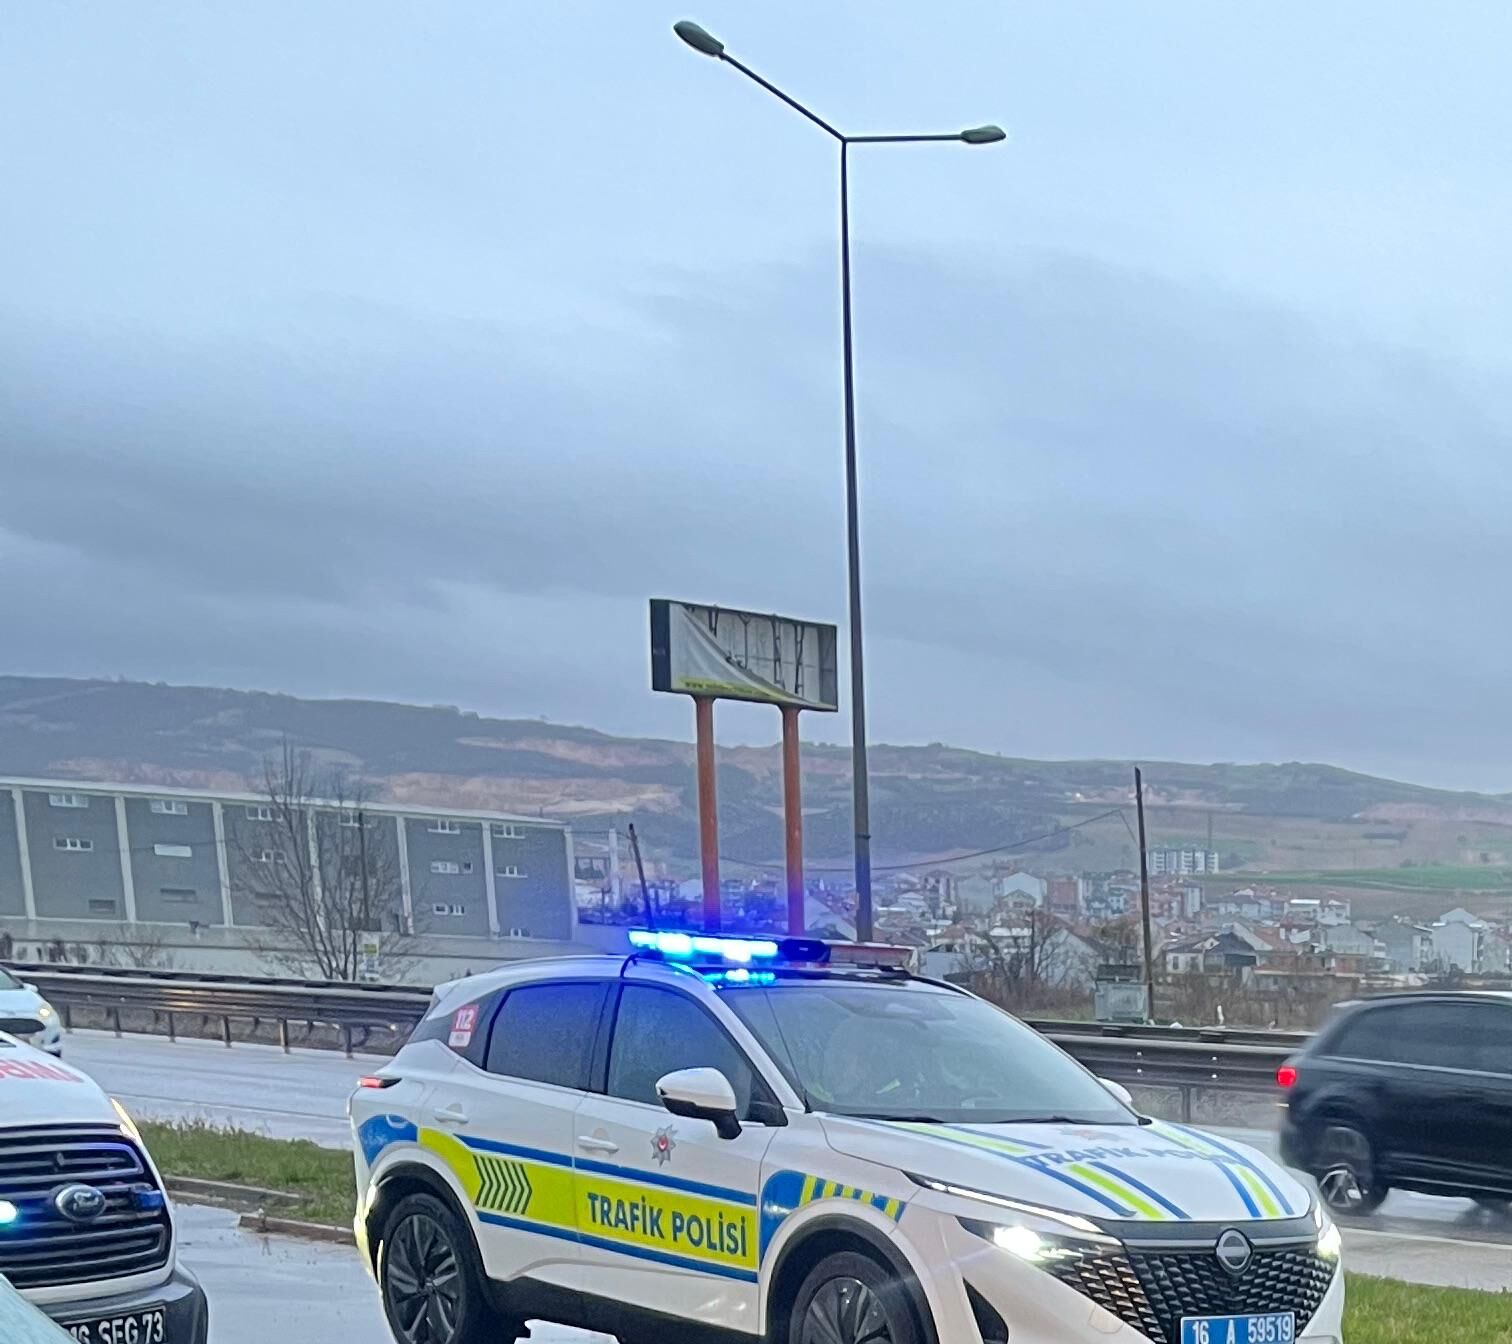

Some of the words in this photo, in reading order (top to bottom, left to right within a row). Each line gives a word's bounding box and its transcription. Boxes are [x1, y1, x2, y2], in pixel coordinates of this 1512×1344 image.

[455, 1009, 475, 1030] 112
[587, 1192, 665, 1239] TRAFİK
[671, 1210, 747, 1257] POLİSİ
[142, 1311, 164, 1344] 73
[1247, 1316, 1292, 1344] 59519
